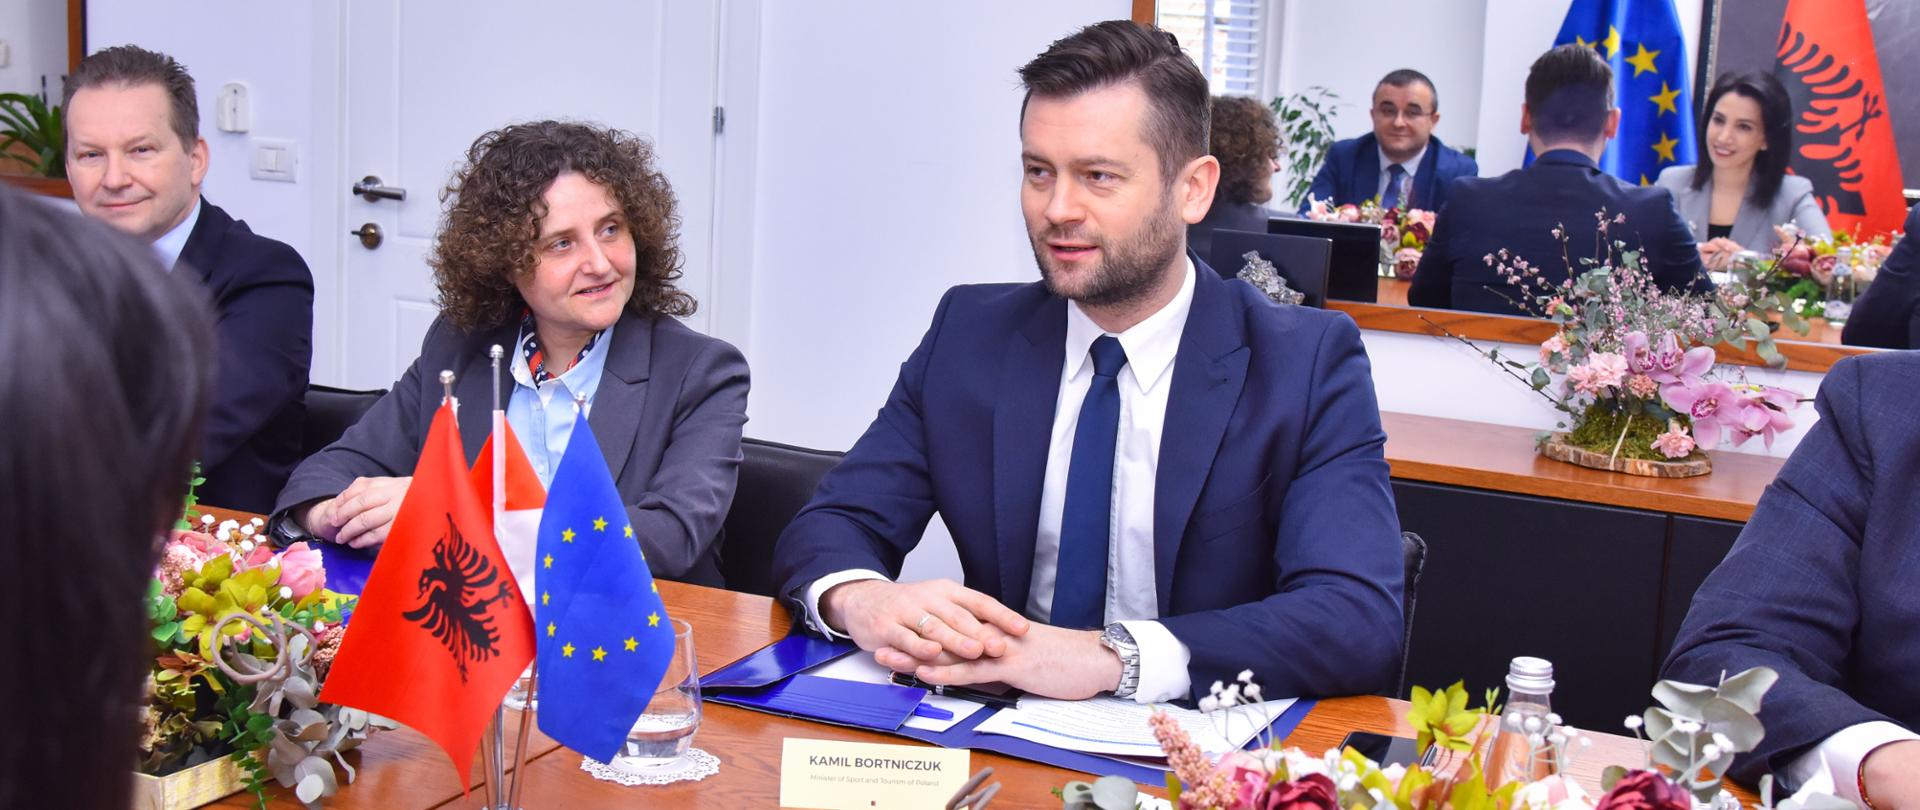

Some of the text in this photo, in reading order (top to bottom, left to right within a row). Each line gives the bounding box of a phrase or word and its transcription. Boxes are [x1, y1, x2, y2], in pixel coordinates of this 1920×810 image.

[810, 755, 941, 771] KAMIL BORTNICZUK
[880, 777, 906, 785] Tourism
